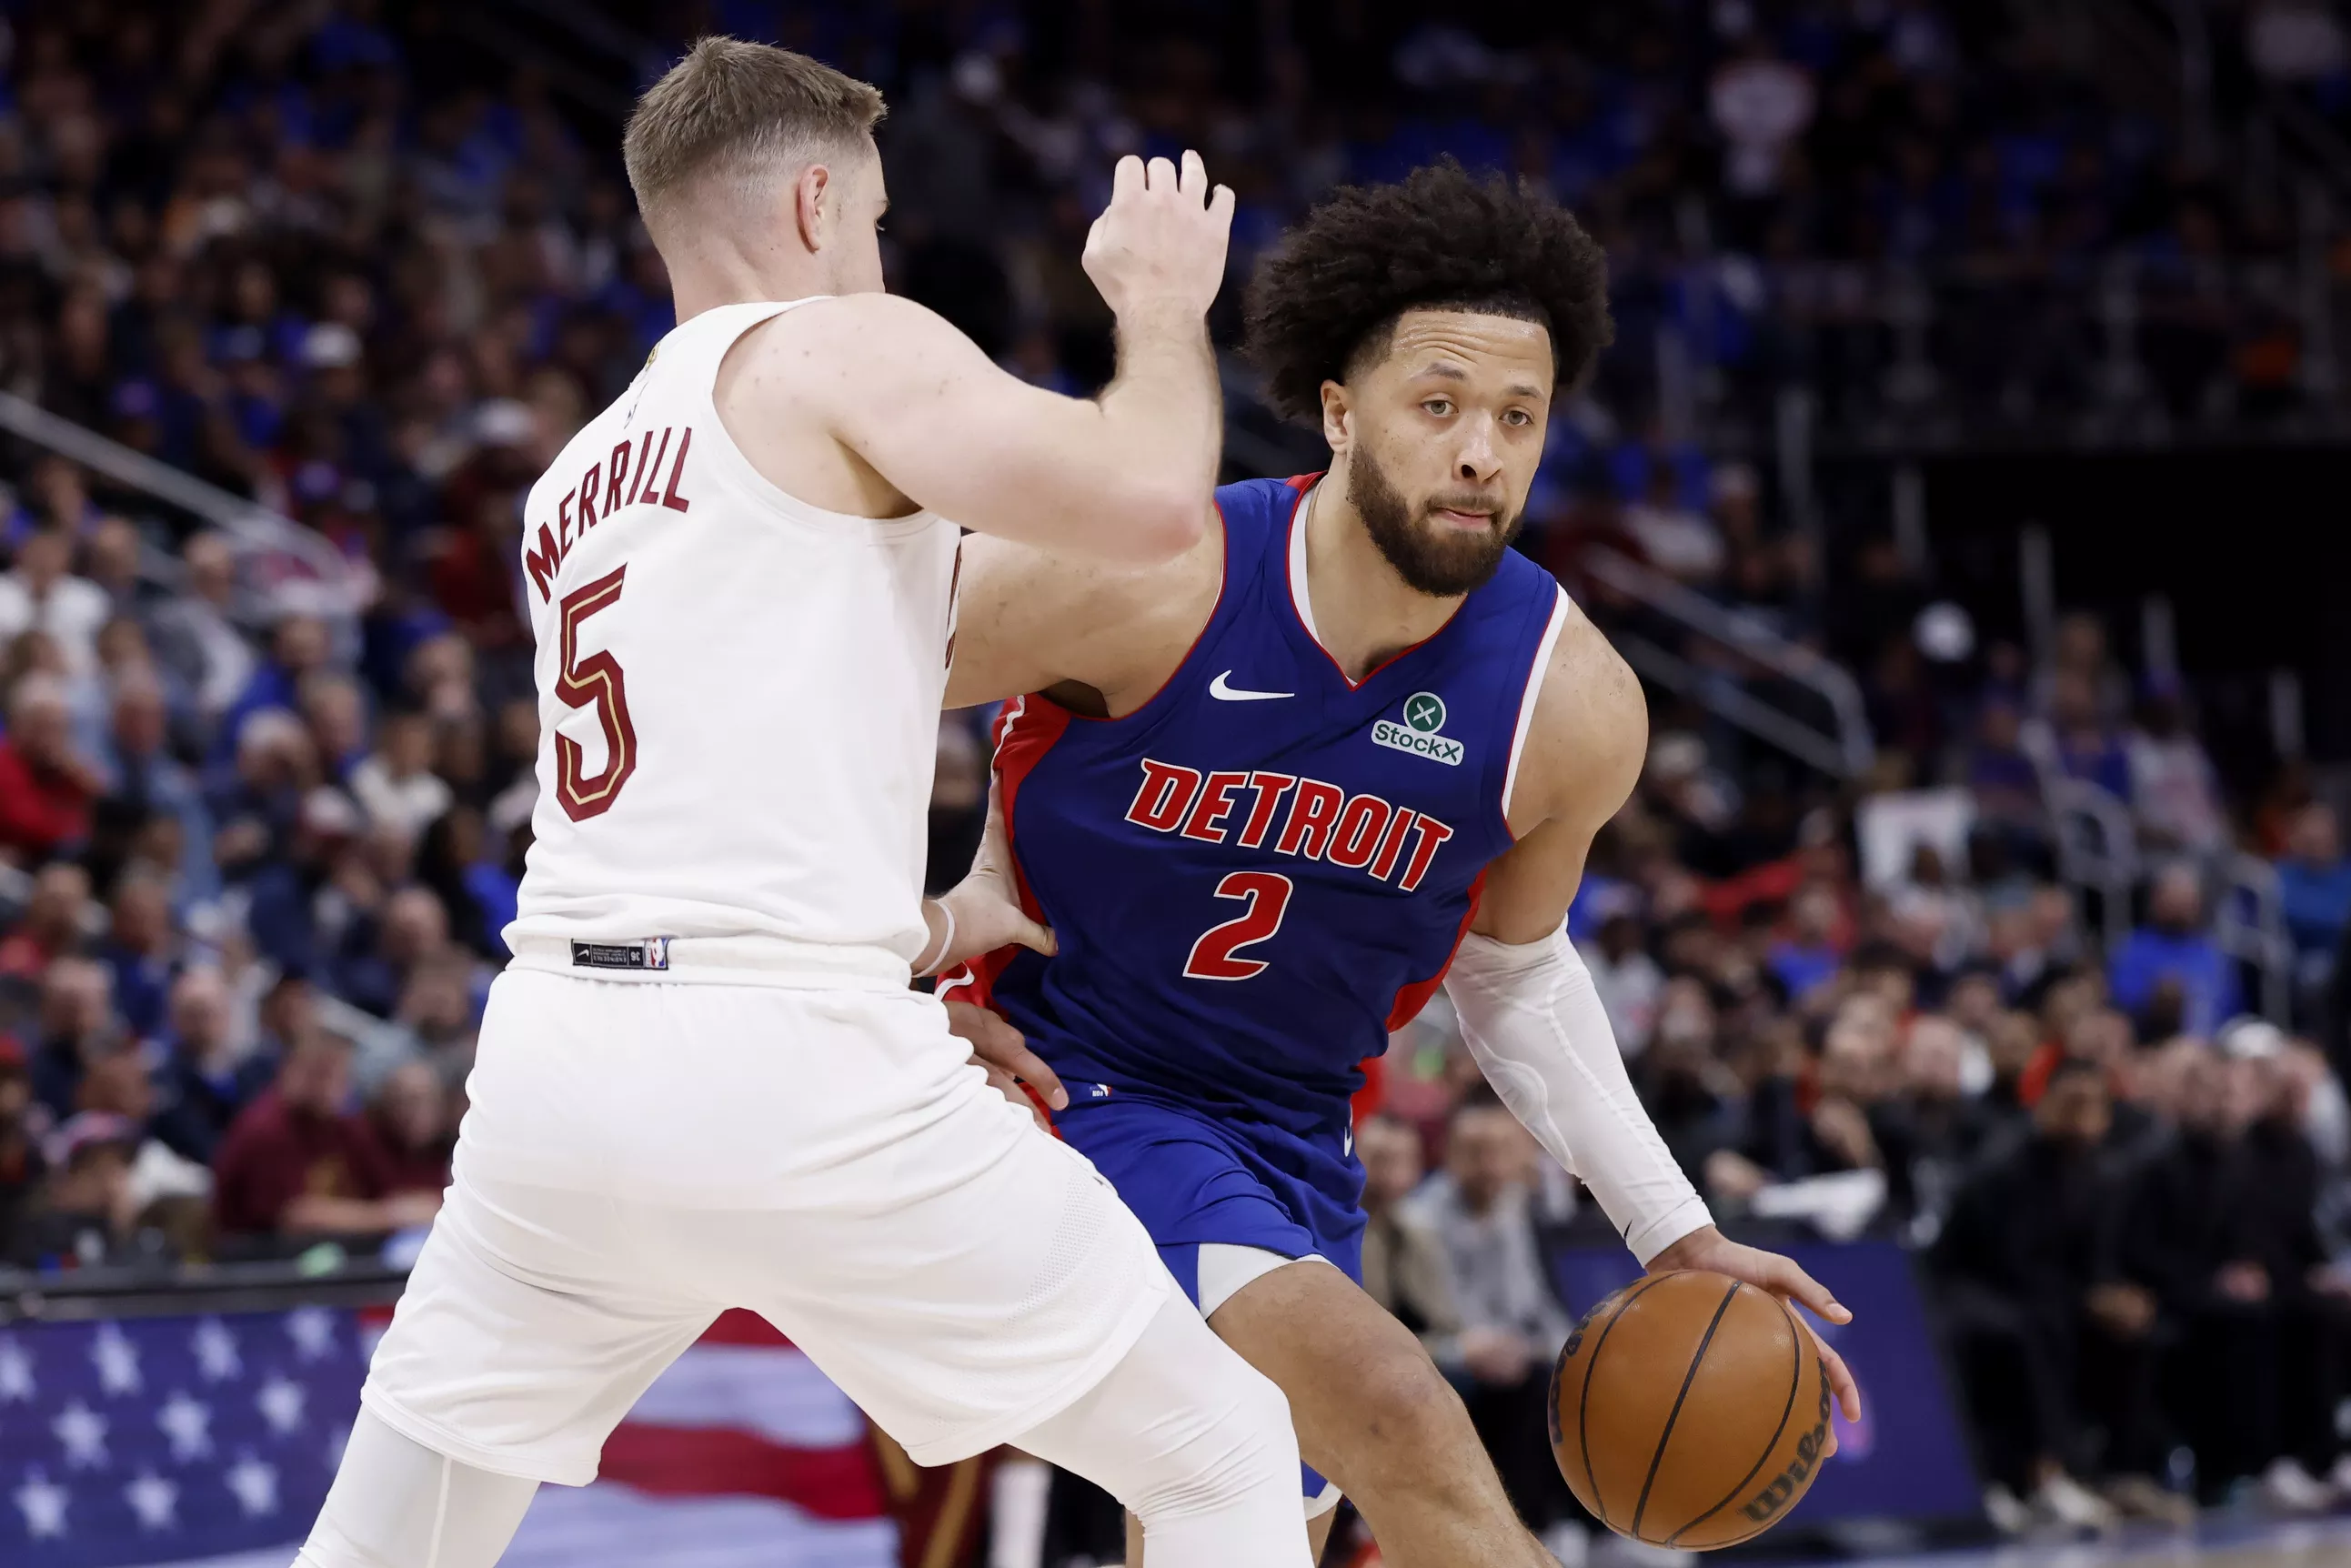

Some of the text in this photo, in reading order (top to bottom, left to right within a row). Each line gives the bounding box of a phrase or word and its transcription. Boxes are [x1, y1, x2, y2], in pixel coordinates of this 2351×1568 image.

[526, 427, 692, 605] MERRILL
[555, 562, 638, 823] 5
[1374, 723, 1461, 764] StockX
[1125, 758, 1453, 892] DETROIT
[1183, 871, 1293, 980] 2
